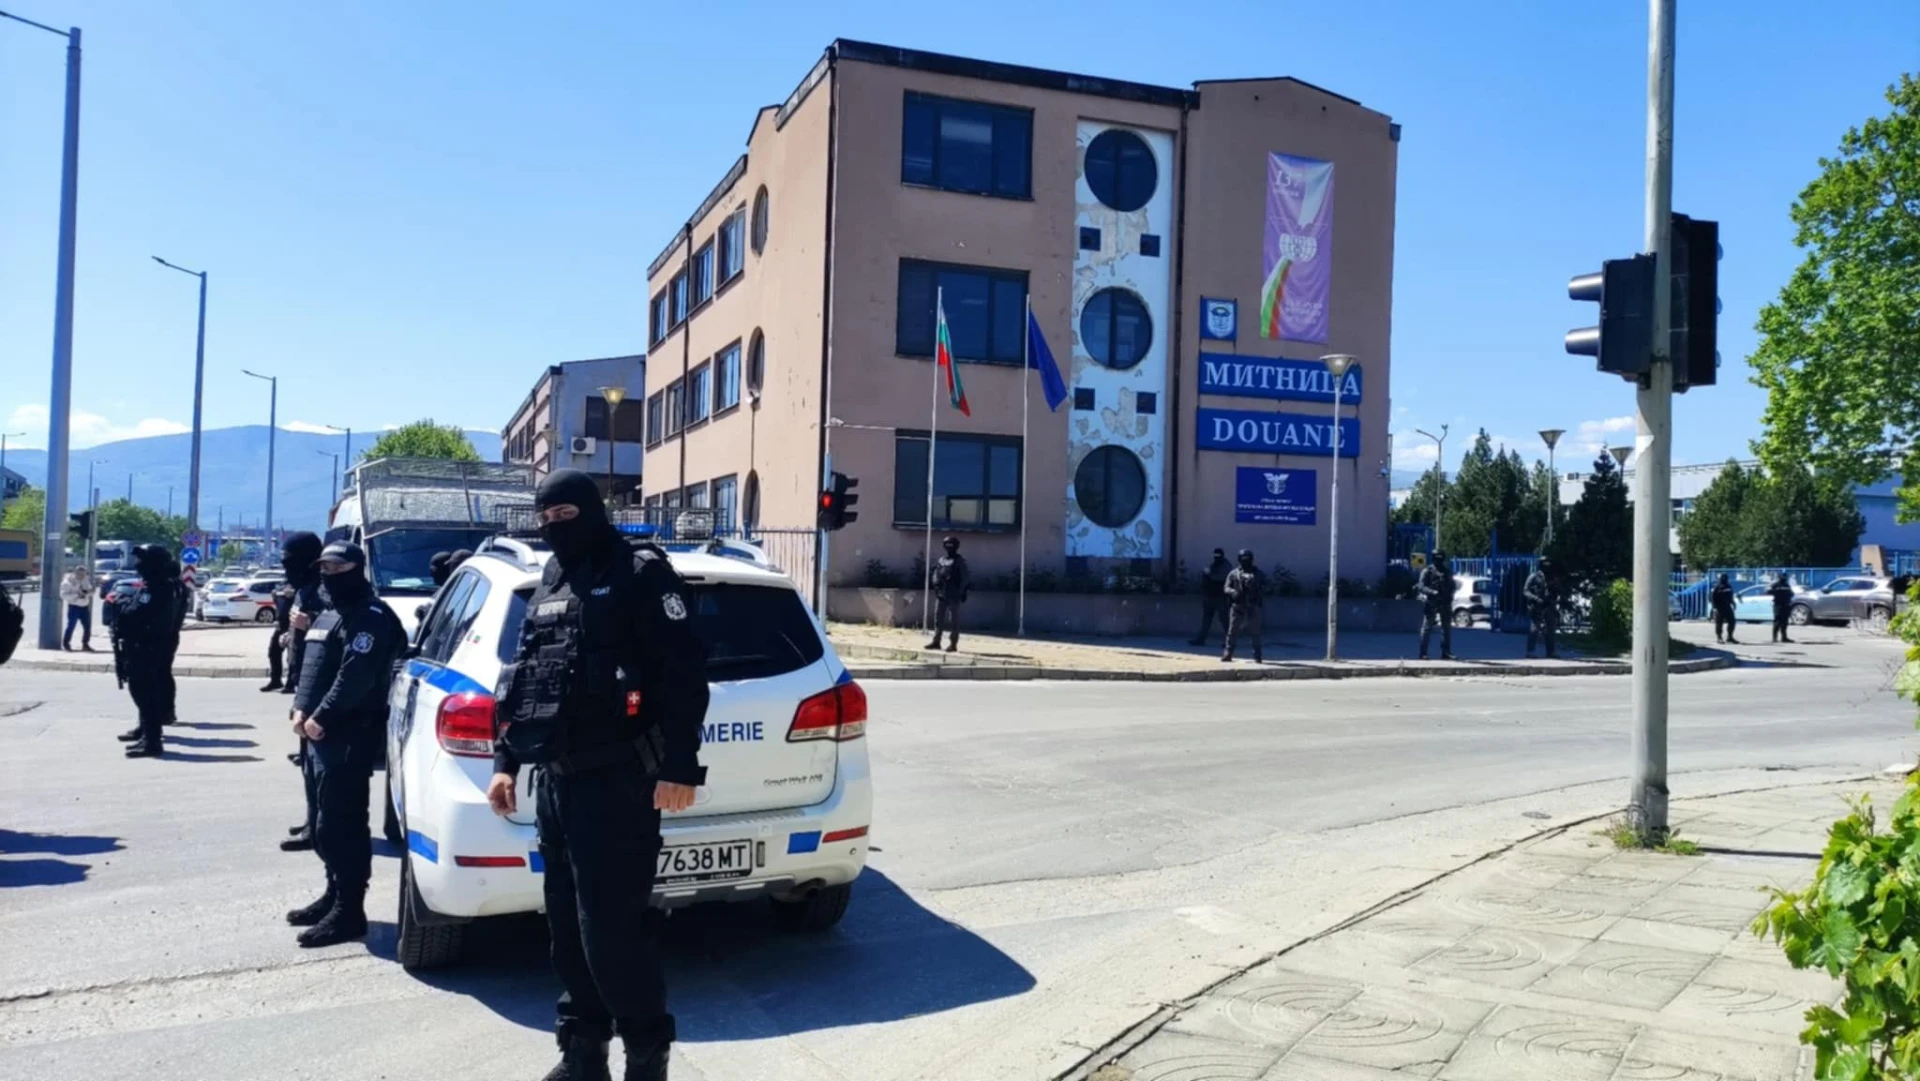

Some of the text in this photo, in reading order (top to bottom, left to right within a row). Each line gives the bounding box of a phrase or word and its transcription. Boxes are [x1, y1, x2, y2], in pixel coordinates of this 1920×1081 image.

[1212, 417, 1345, 448] DOUANE
[660, 845, 747, 874] 7638 MT
